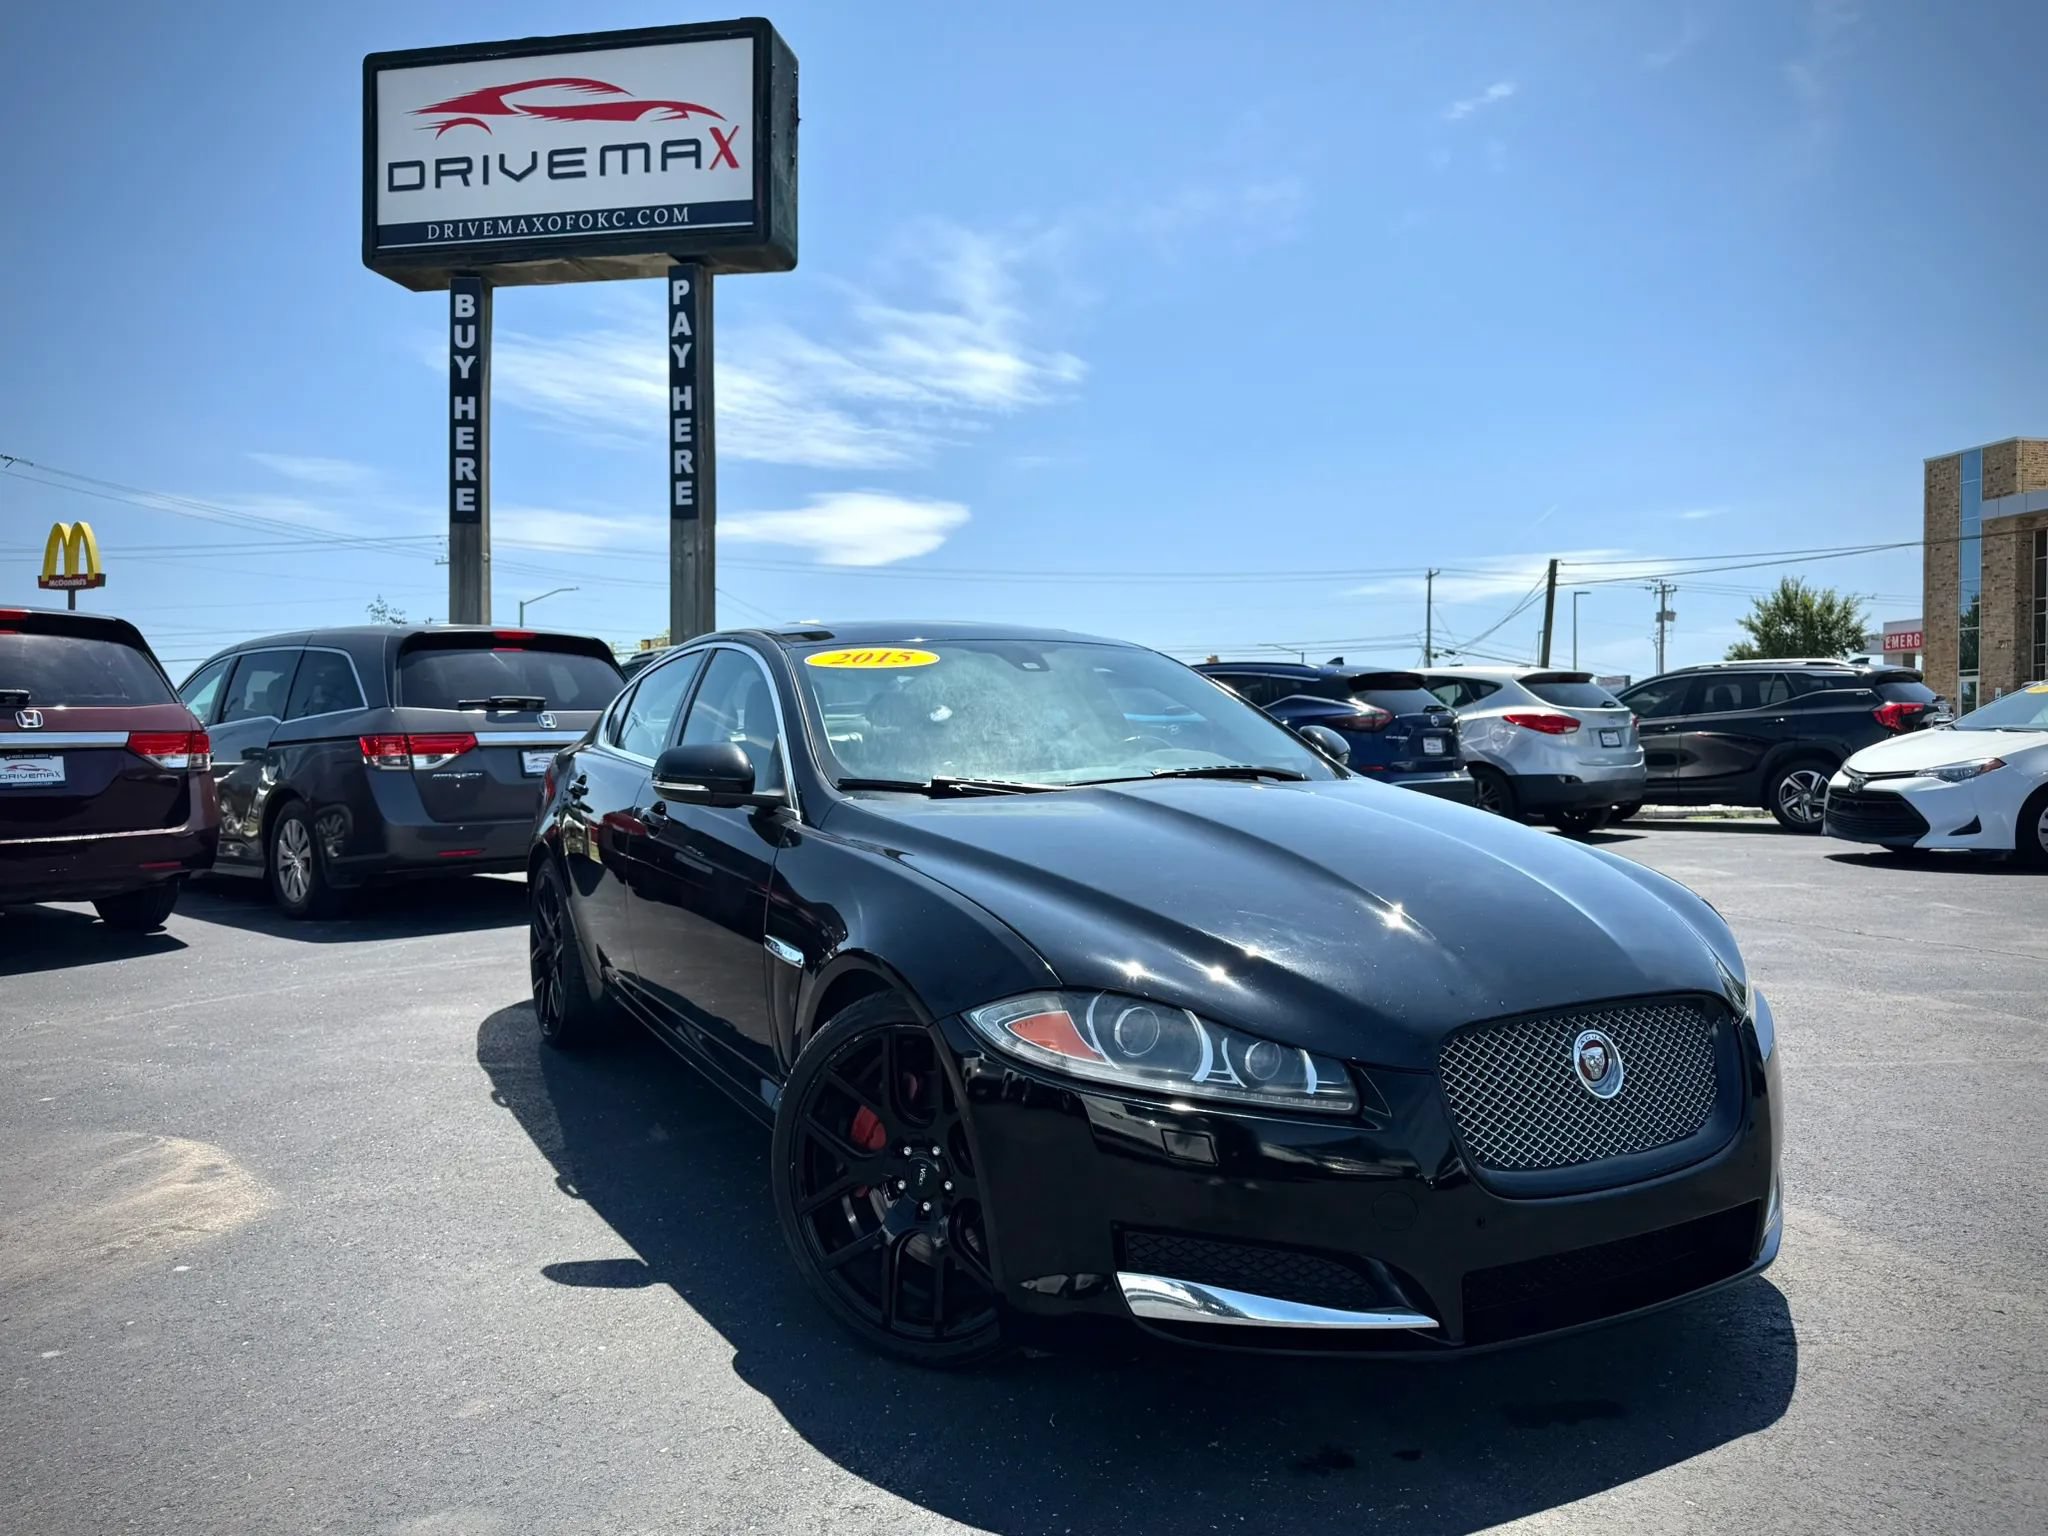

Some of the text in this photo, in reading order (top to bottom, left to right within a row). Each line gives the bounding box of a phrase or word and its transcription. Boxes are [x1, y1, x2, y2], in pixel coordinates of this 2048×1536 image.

[388, 125, 740, 193] DRIVEMAX
[427, 206, 690, 240] DRIVEMAXOFOKC.COM
[454, 294, 477, 511] BUY HERE
[671, 279, 694, 505] PAY HERE
[829, 651, 916, 665] 2015
[1885, 633, 1920, 649] EMERG
